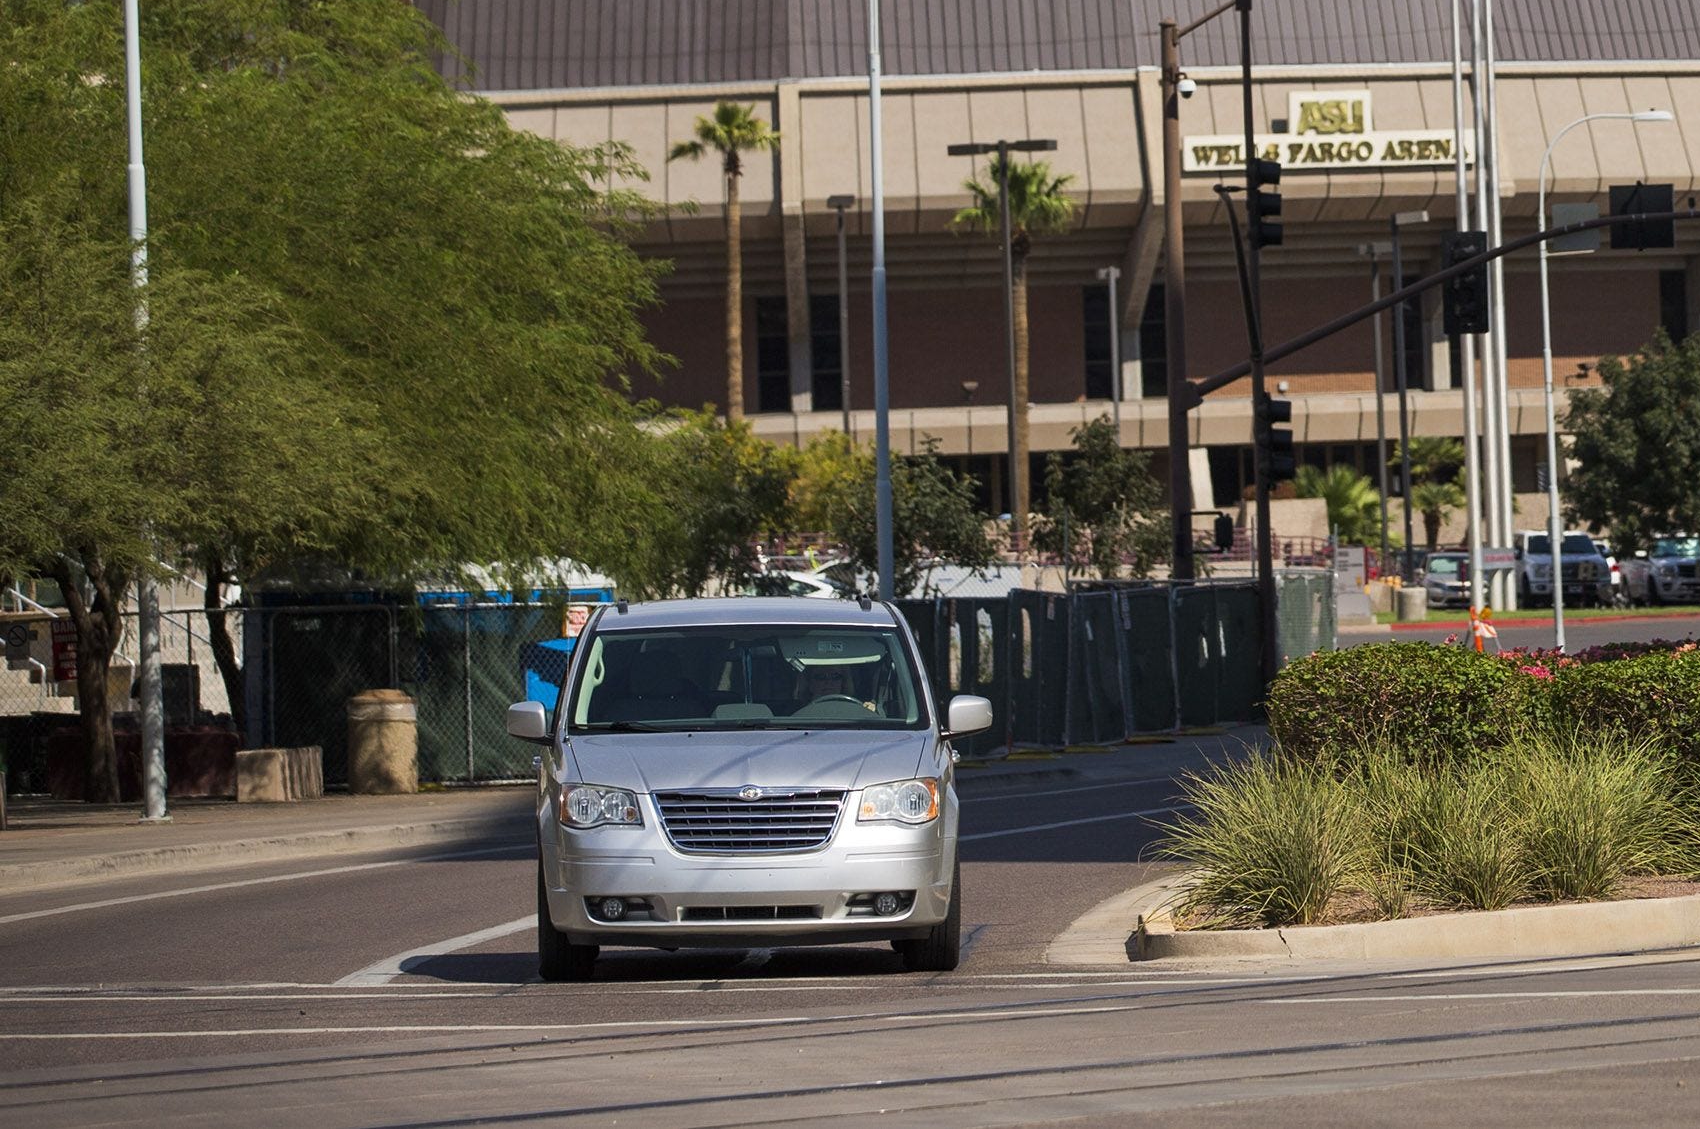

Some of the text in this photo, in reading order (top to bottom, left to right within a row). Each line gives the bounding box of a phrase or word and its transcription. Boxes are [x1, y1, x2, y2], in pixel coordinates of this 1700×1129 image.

[1298, 100, 1363, 135] ASU
[1192, 143, 1280, 165] WELS
[1288, 141, 1373, 163] FARGO
